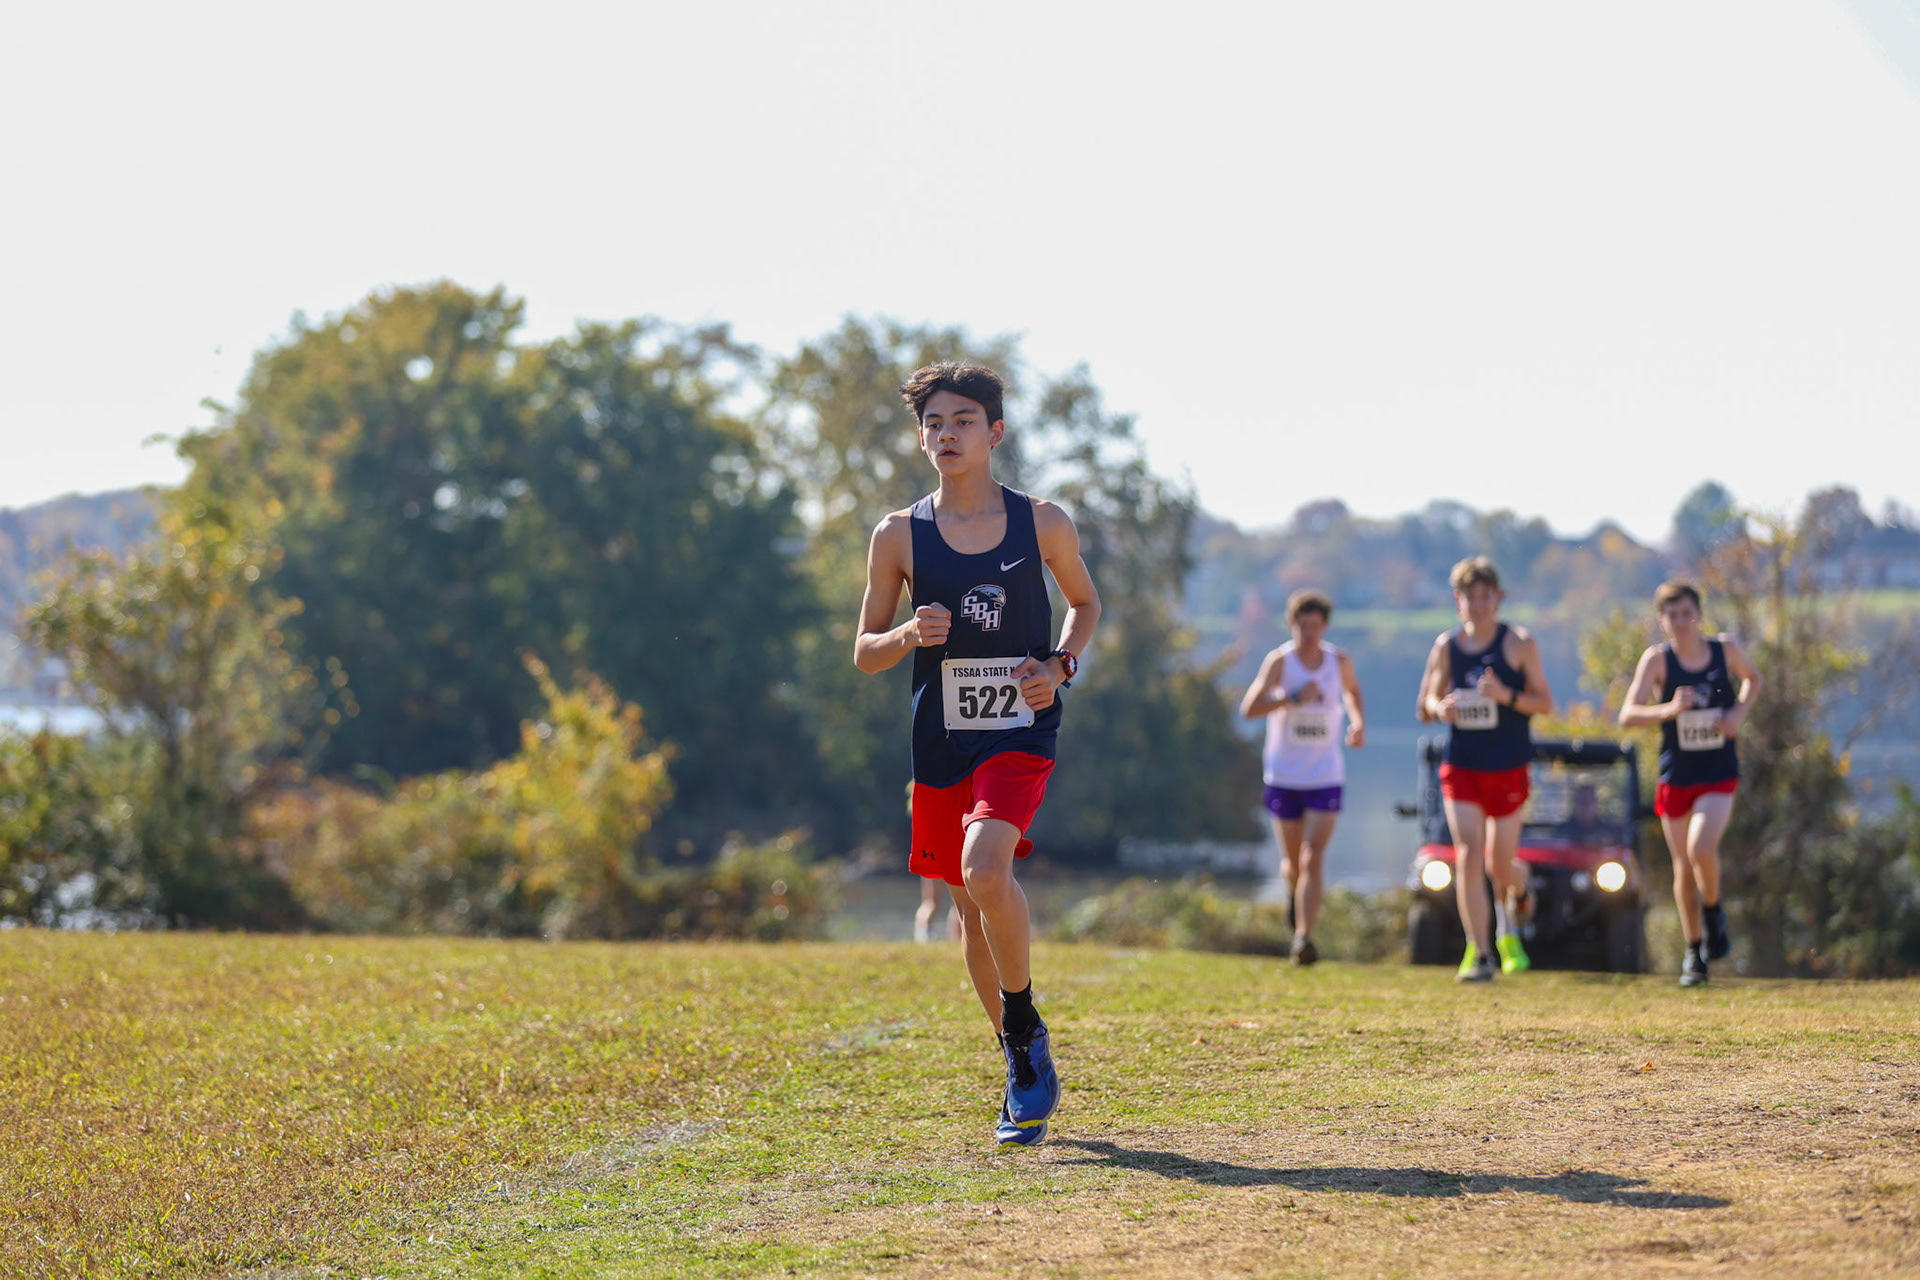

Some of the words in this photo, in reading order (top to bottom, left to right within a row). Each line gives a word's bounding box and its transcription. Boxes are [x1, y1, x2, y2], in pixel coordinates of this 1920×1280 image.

[963, 595, 999, 629] SBA
[952, 666, 981, 678] TSSAA
[983, 666, 1008, 677] STATE
[958, 684, 1018, 719] 522
